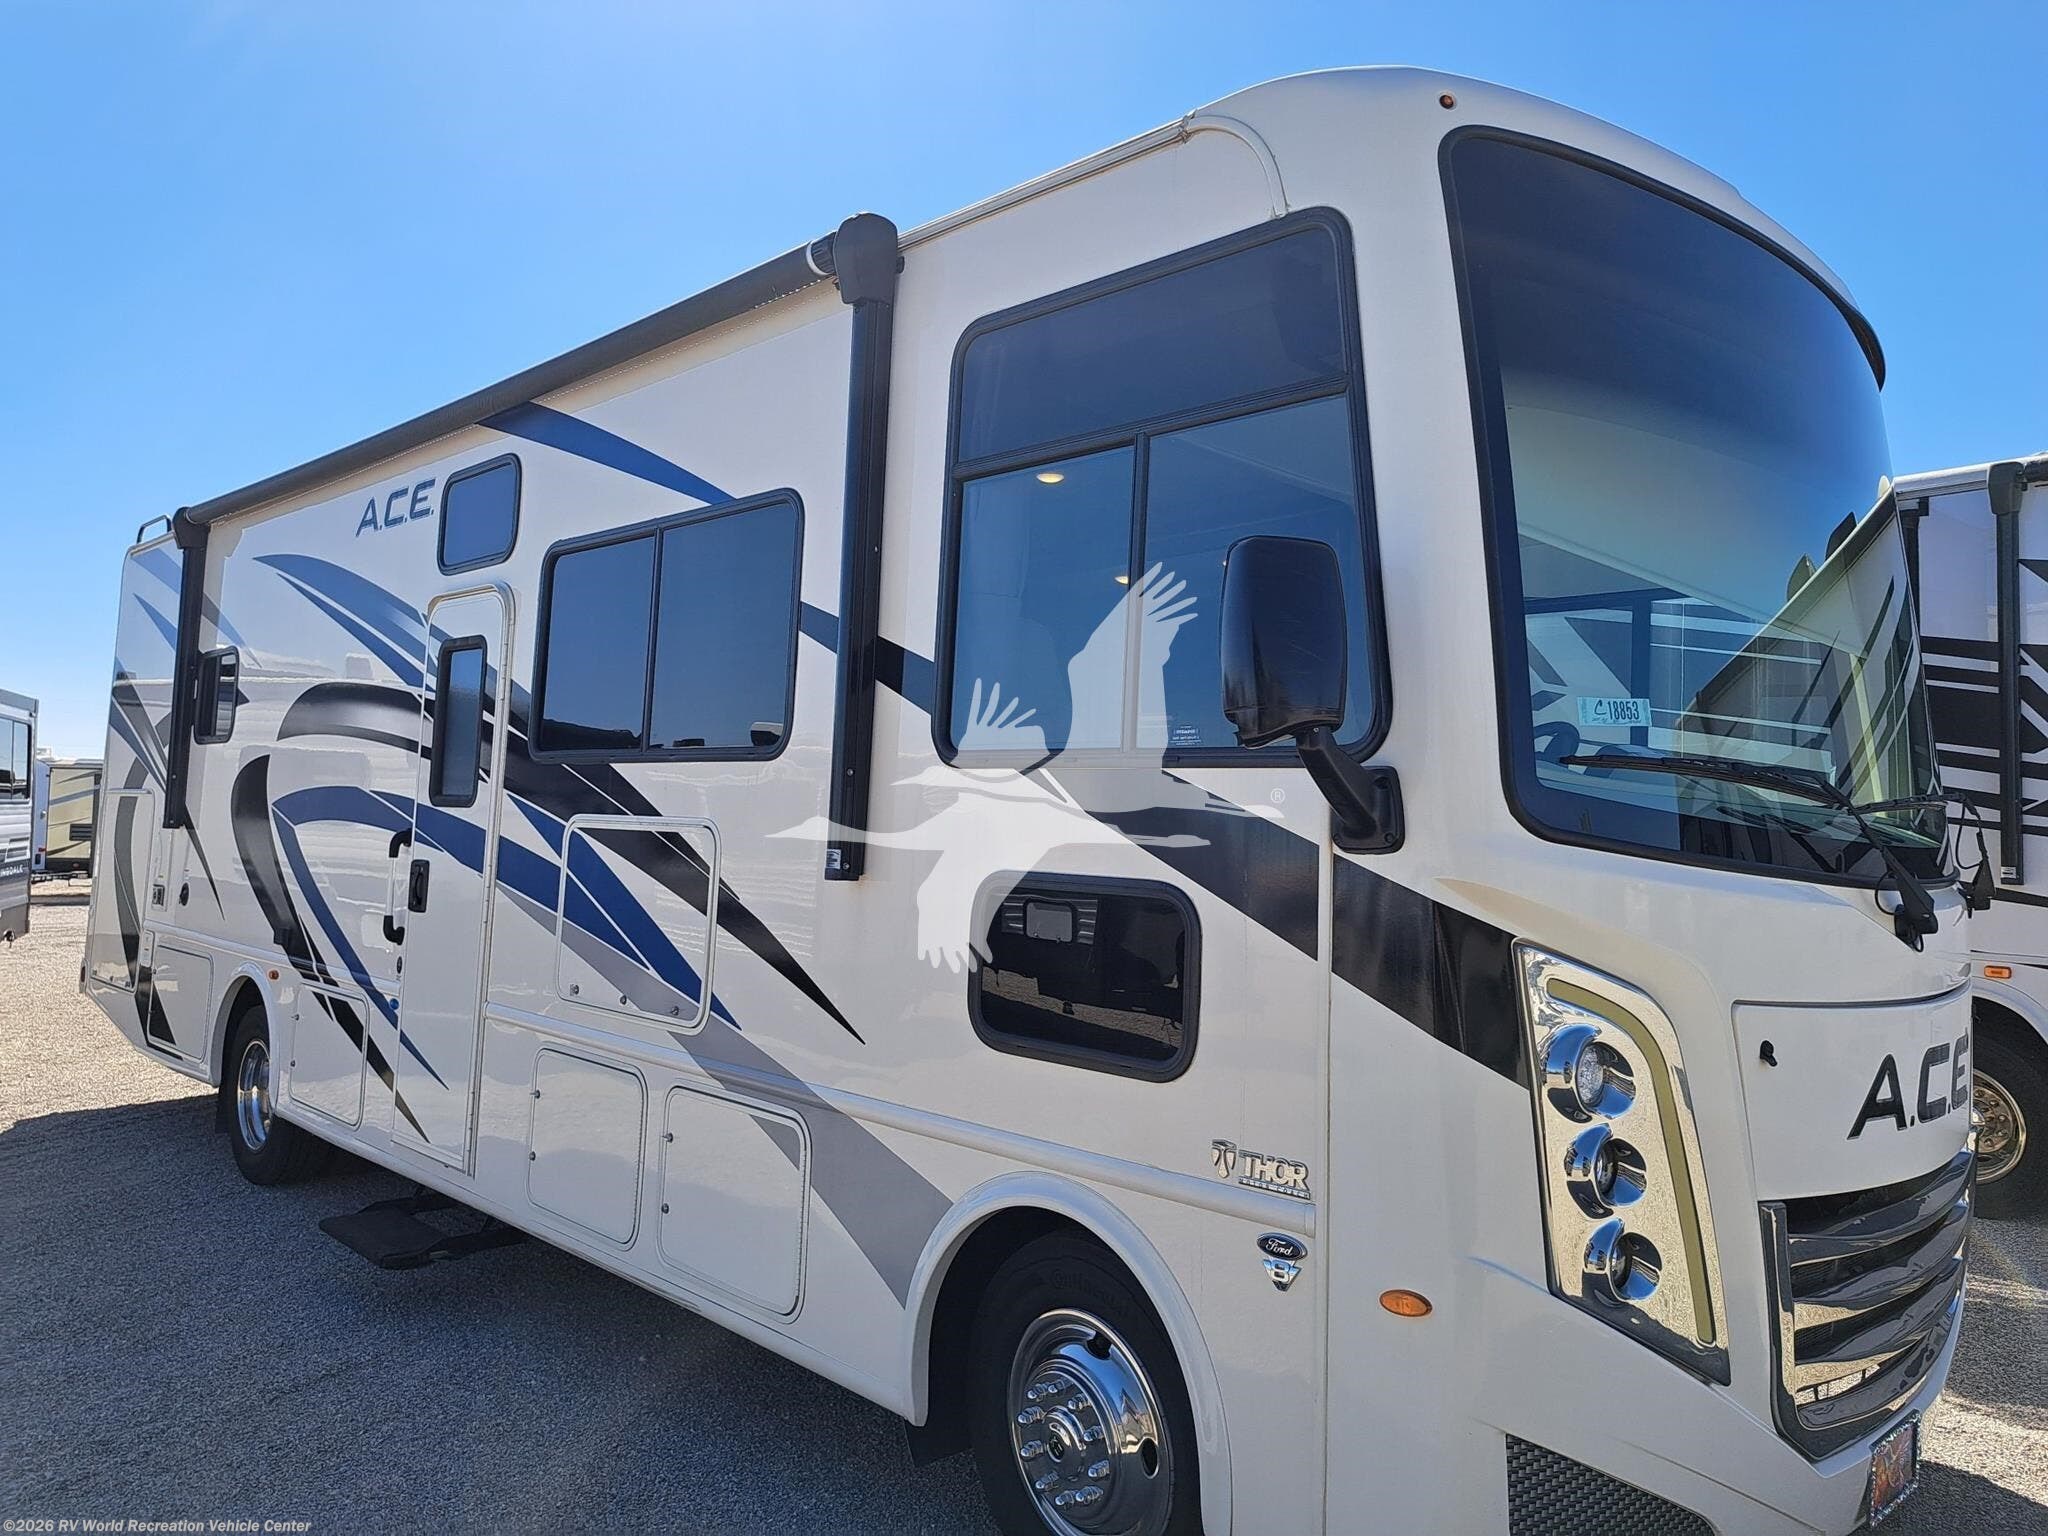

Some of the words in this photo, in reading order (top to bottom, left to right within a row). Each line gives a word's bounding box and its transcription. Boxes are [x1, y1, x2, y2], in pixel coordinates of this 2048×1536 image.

[1608, 700, 1640, 720] 18853
[1239, 1150, 1310, 1192] THOR
[1265, 1238, 1294, 1256] Ford
